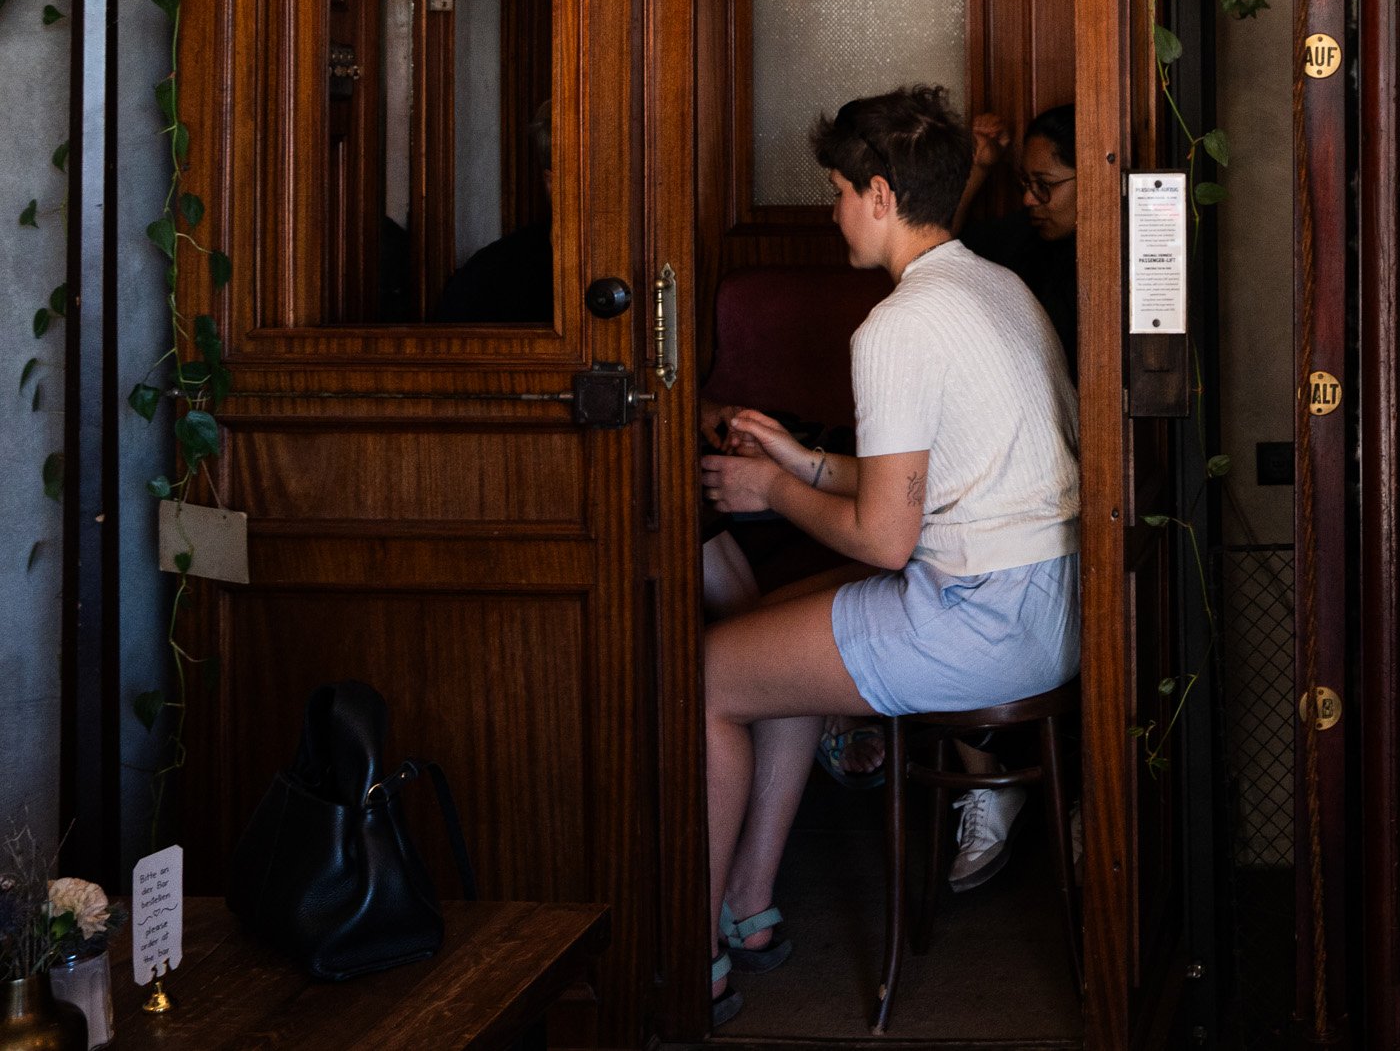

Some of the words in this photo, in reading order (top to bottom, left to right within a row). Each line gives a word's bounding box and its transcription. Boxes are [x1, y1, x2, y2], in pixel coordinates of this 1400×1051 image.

[1306, 46, 1338, 67] AUF
[1310, 383, 1338, 404] ALT
[140, 871, 156, 884] Bitte
[160, 867, 169, 875] an
[141, 886, 153, 896] der
[156, 879, 169, 890] Bar
[141, 893, 171, 909] bestellen
[145, 921, 168, 939] please
[140, 938, 158, 951] order
[162, 932, 169, 941] at
[143, 952, 154, 964] the
[158, 946, 170, 957] bar
